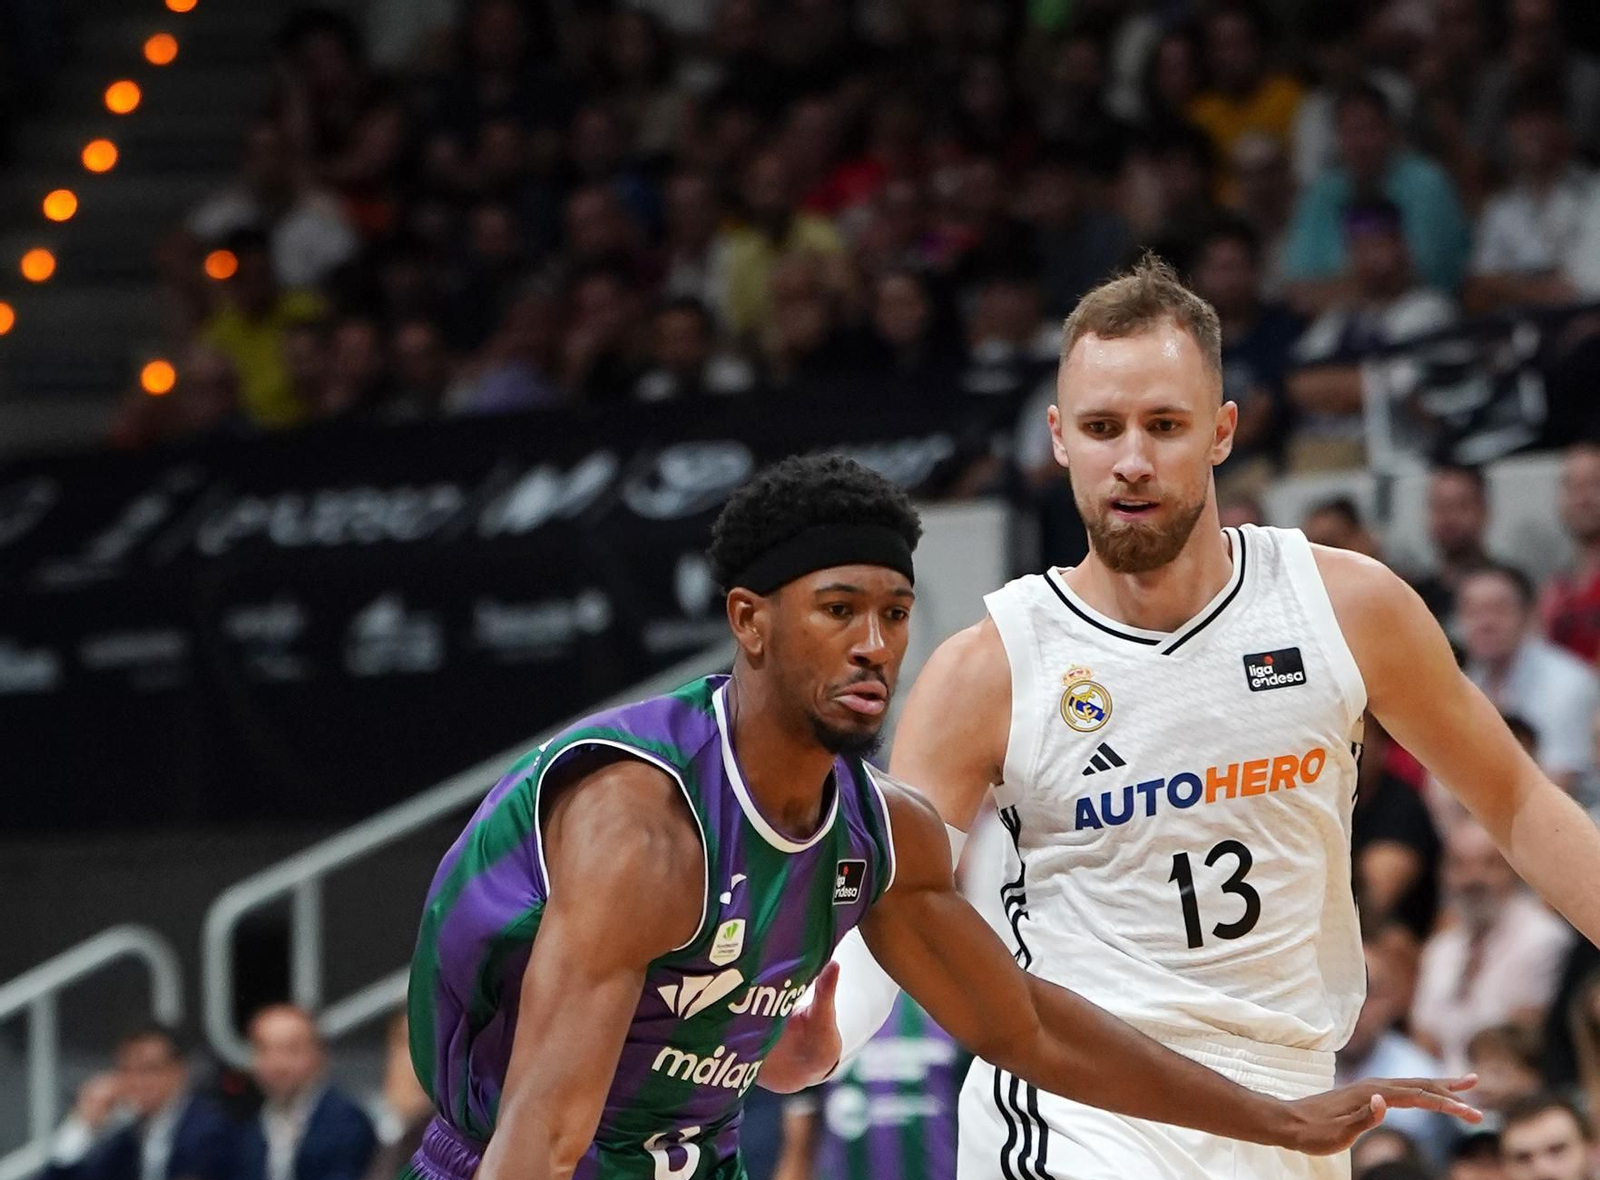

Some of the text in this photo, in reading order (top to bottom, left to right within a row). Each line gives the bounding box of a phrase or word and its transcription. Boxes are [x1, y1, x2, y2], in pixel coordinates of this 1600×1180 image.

[1248, 664, 1274, 678] liga
[1251, 671, 1304, 688] endesa
[1074, 747, 1327, 831] AUTOHERO
[1167, 839, 1262, 950] 13
